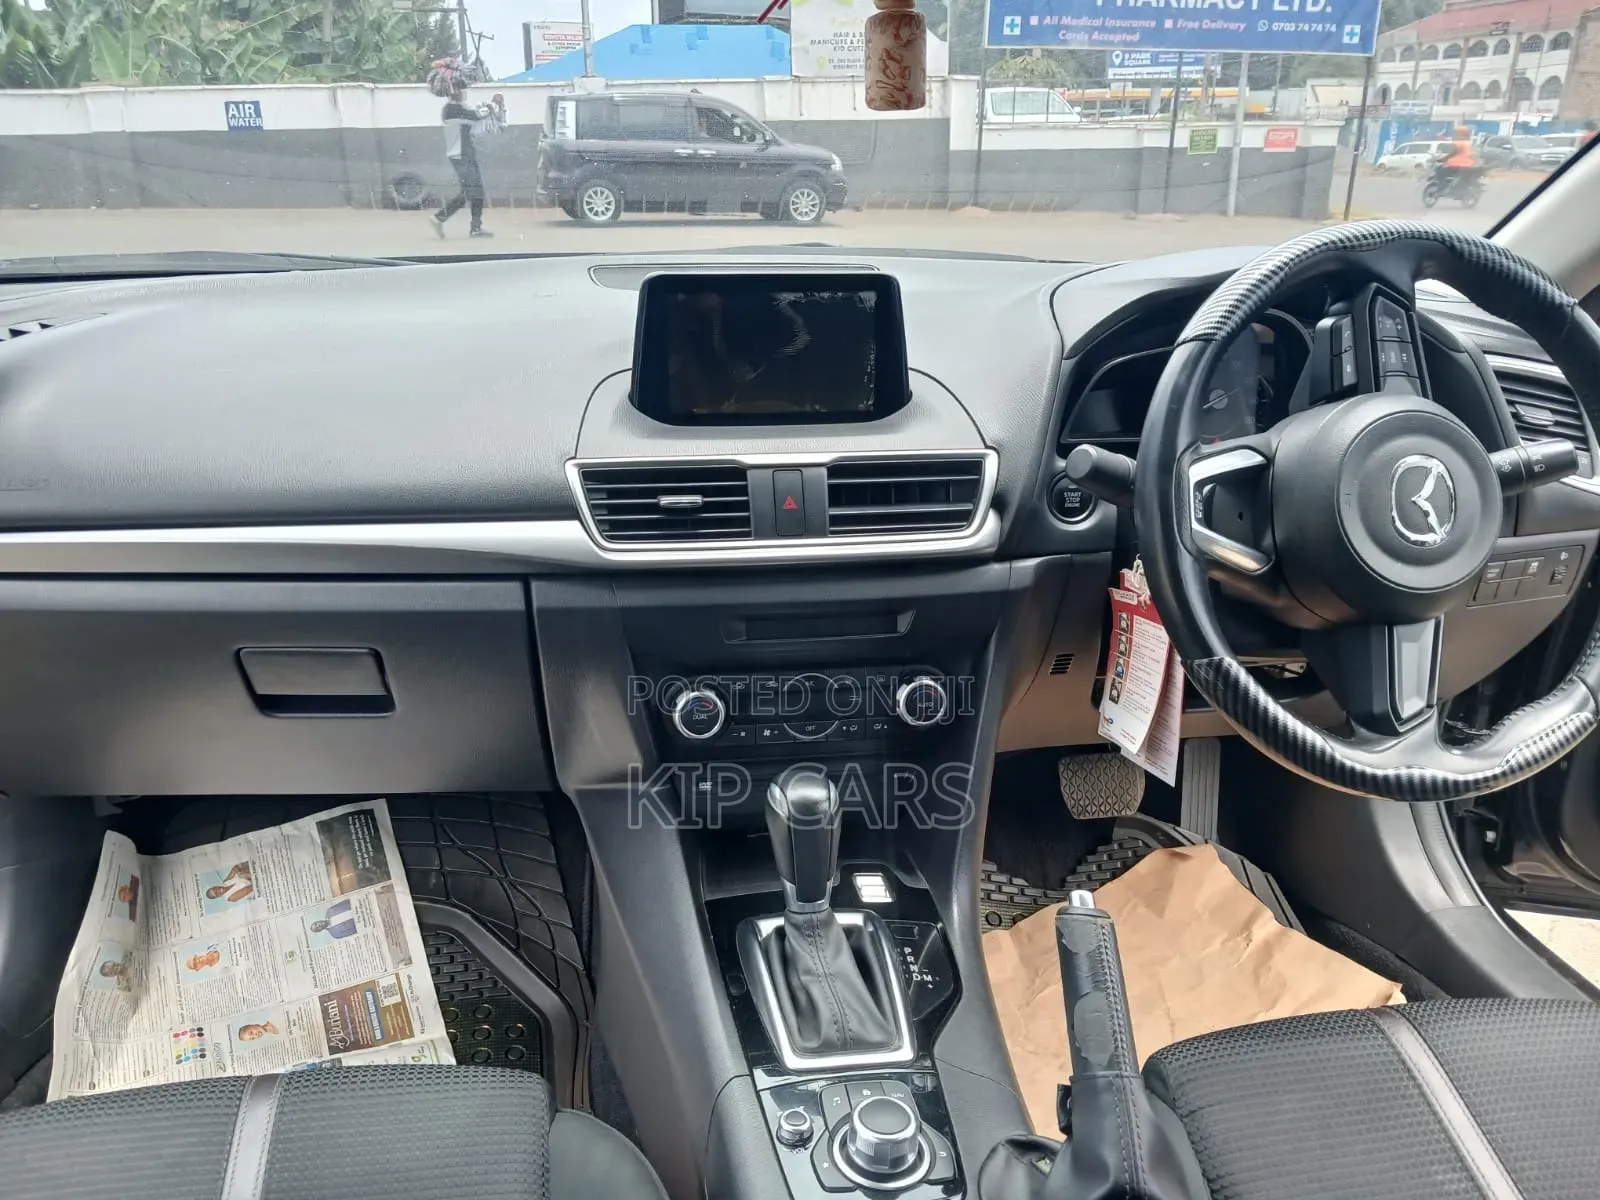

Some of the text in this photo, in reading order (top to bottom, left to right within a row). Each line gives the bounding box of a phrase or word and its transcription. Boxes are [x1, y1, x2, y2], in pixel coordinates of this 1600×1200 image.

[1043, 15, 1157, 28] All Medical Insurance
[1177, 19, 1247, 32] Free Delivery
[1058, 30, 1141, 43] Cards Accepted
[229, 103, 257, 118] AIR
[229, 117, 264, 127] WATER
[692, 713, 709, 721] DUAL
[904, 946, 912, 955] P
[906, 955, 915, 963] R
[909, 963, 919, 972] N
[912, 972, 933, 982] D M
